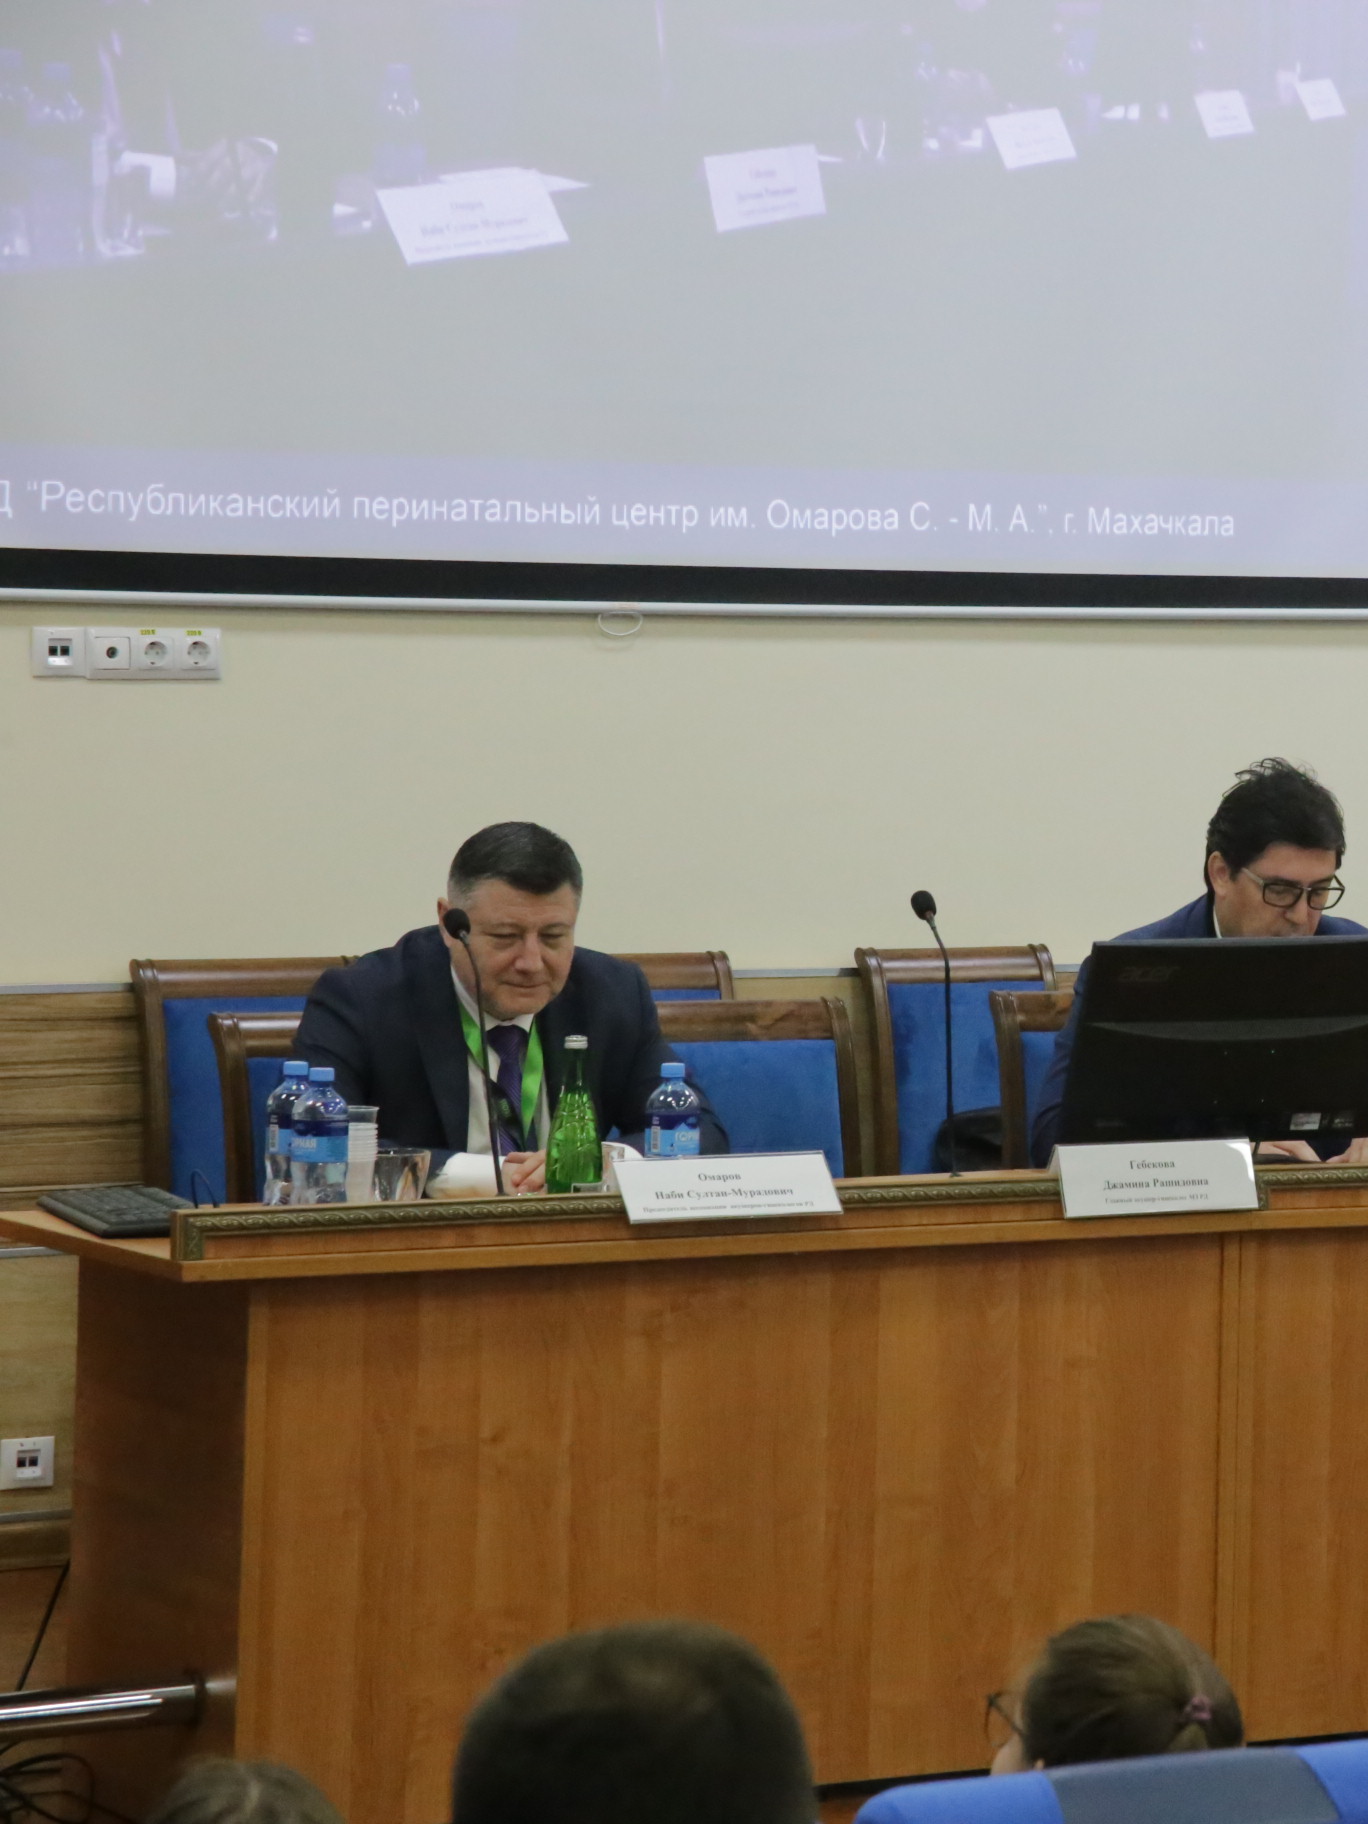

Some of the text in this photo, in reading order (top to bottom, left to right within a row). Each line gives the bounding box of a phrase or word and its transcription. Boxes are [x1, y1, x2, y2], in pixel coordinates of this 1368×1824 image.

[354, 496, 600, 528] перинатальный
[611, 503, 700, 535] центр
[710, 506, 755, 528] им.
[767, 499, 898, 538] Омарова
[1088, 507, 1234, 537] Махачкала
[1129, 1159, 1176, 1171] Гебекова
[698, 1172, 742, 1183] Омаров
[1103, 1177, 1209, 1191] Джамина Рашидовна
[655, 1187, 794, 1202] Наби Султан-Мурадович
